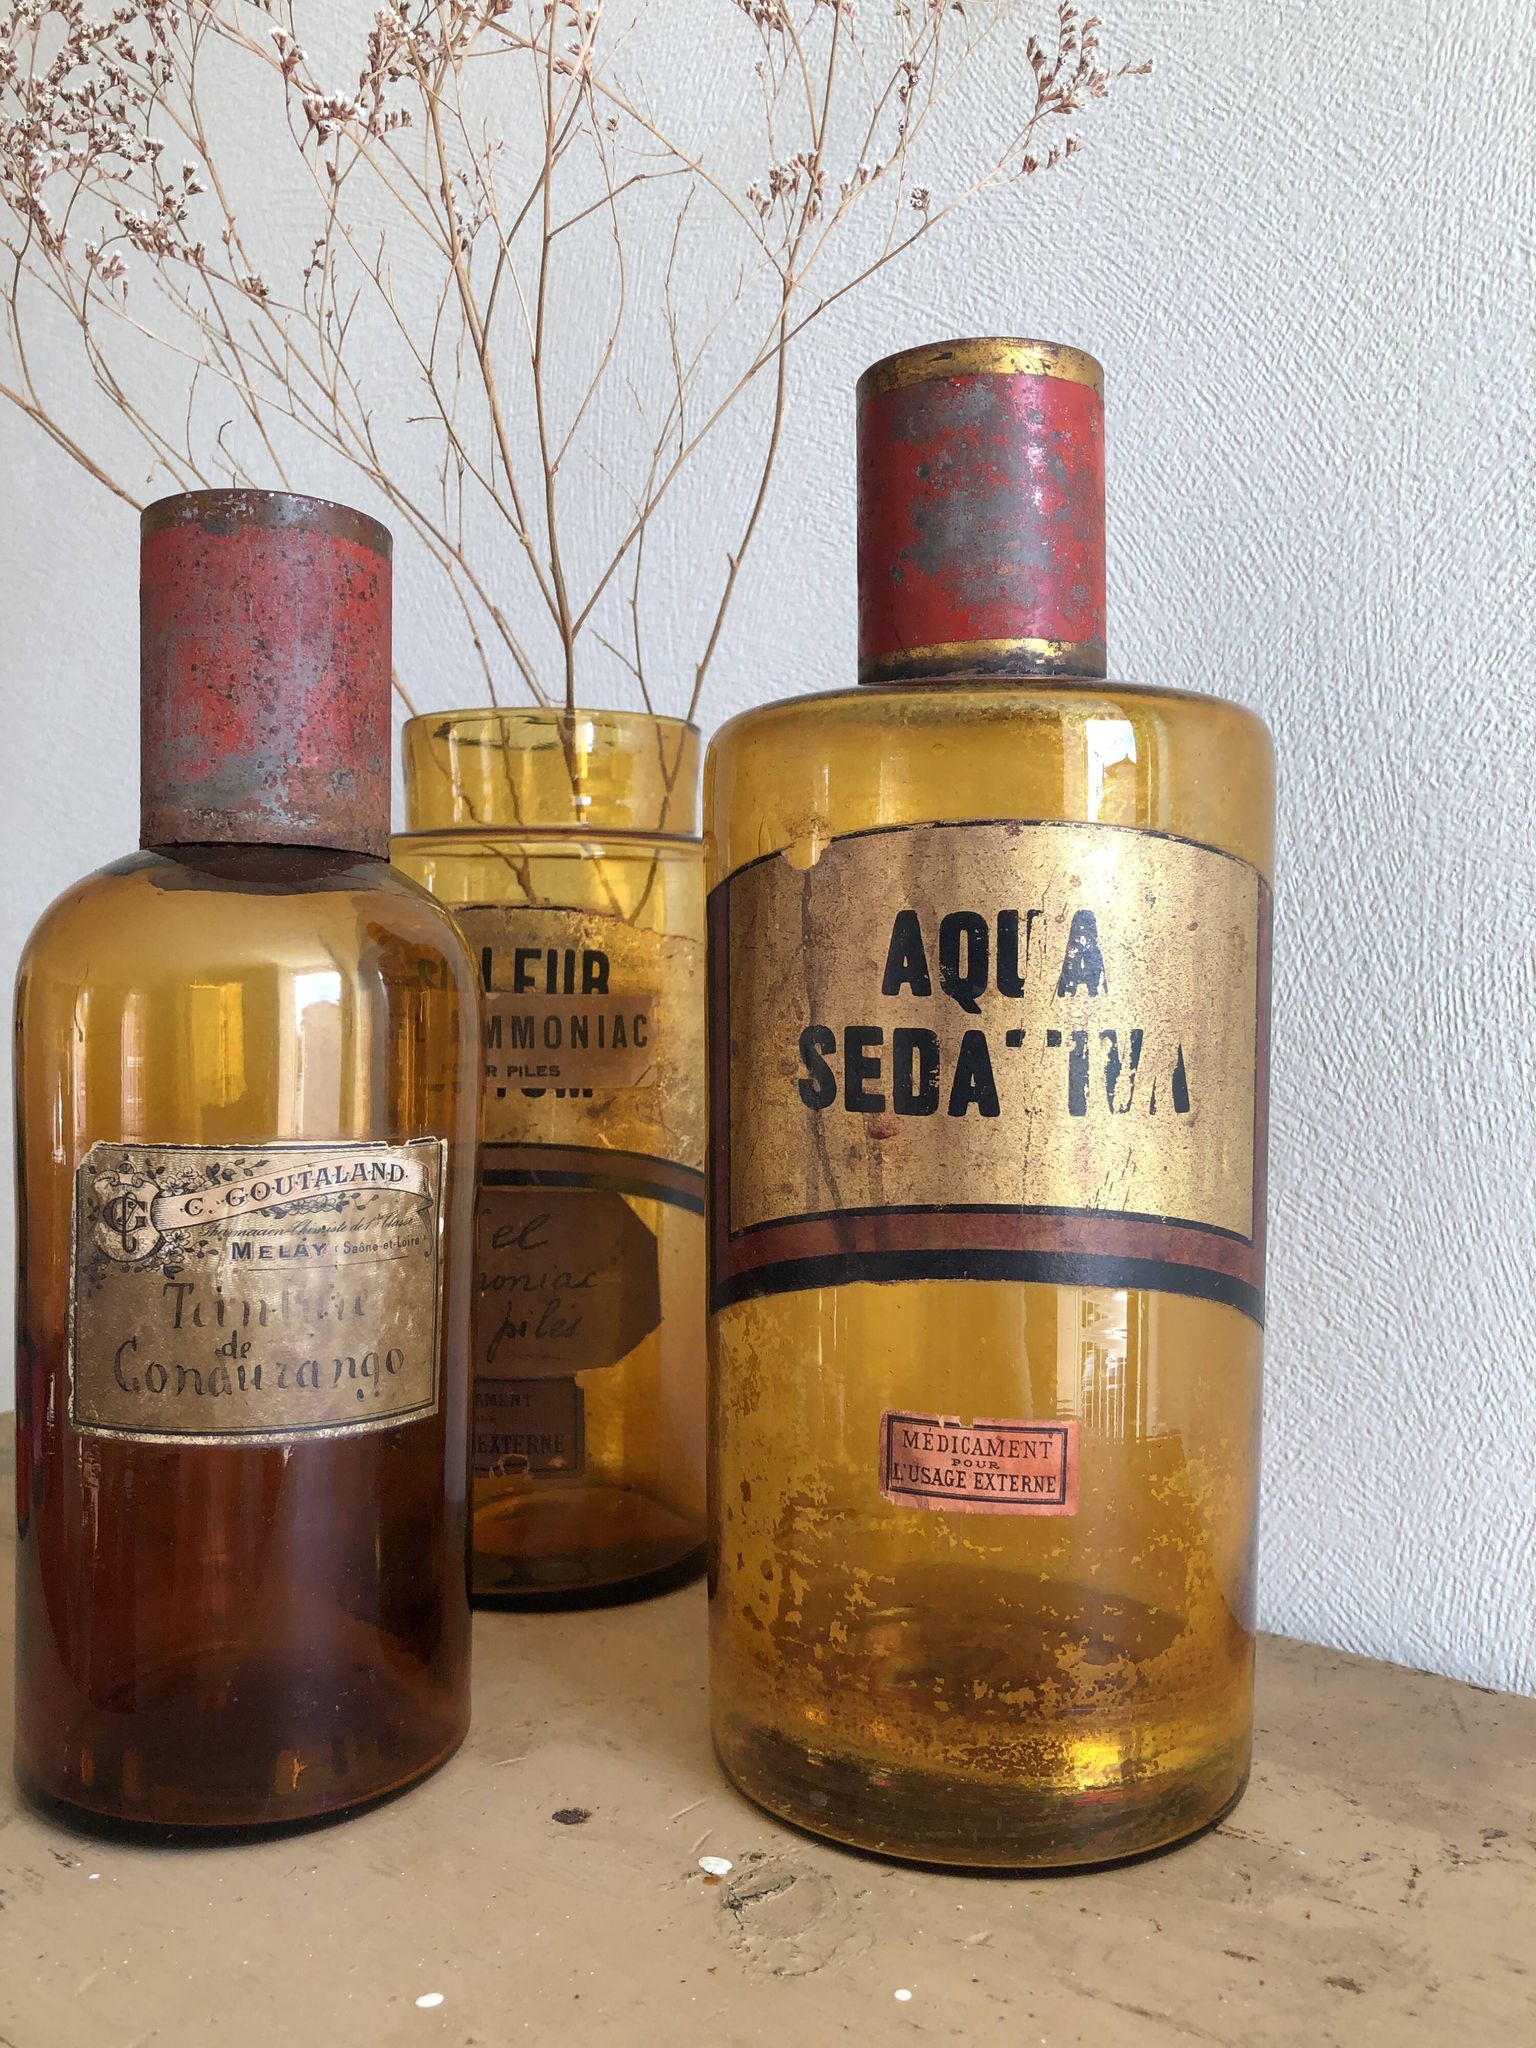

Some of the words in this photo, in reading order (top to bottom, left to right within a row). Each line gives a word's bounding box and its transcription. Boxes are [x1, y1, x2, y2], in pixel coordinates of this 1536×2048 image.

[881, 909, 1109, 1014] AQUA
[507, 1065, 561, 1078] PILES
[799, 1025, 1190, 1117] SEDAIV
[225, 1162, 406, 1207] GOUTALAND
[231, 1240, 327, 1260] MELAY
[222, 1330, 252, 1360] de
[486, 1300, 583, 1363] piles
[902, 1427, 1053, 1459] MÉDICAMENT
[892, 1462, 967, 1489] L'USAGE
[973, 1471, 1057, 1493] EXTERNE
[950, 1458, 1001, 1469] POUR
